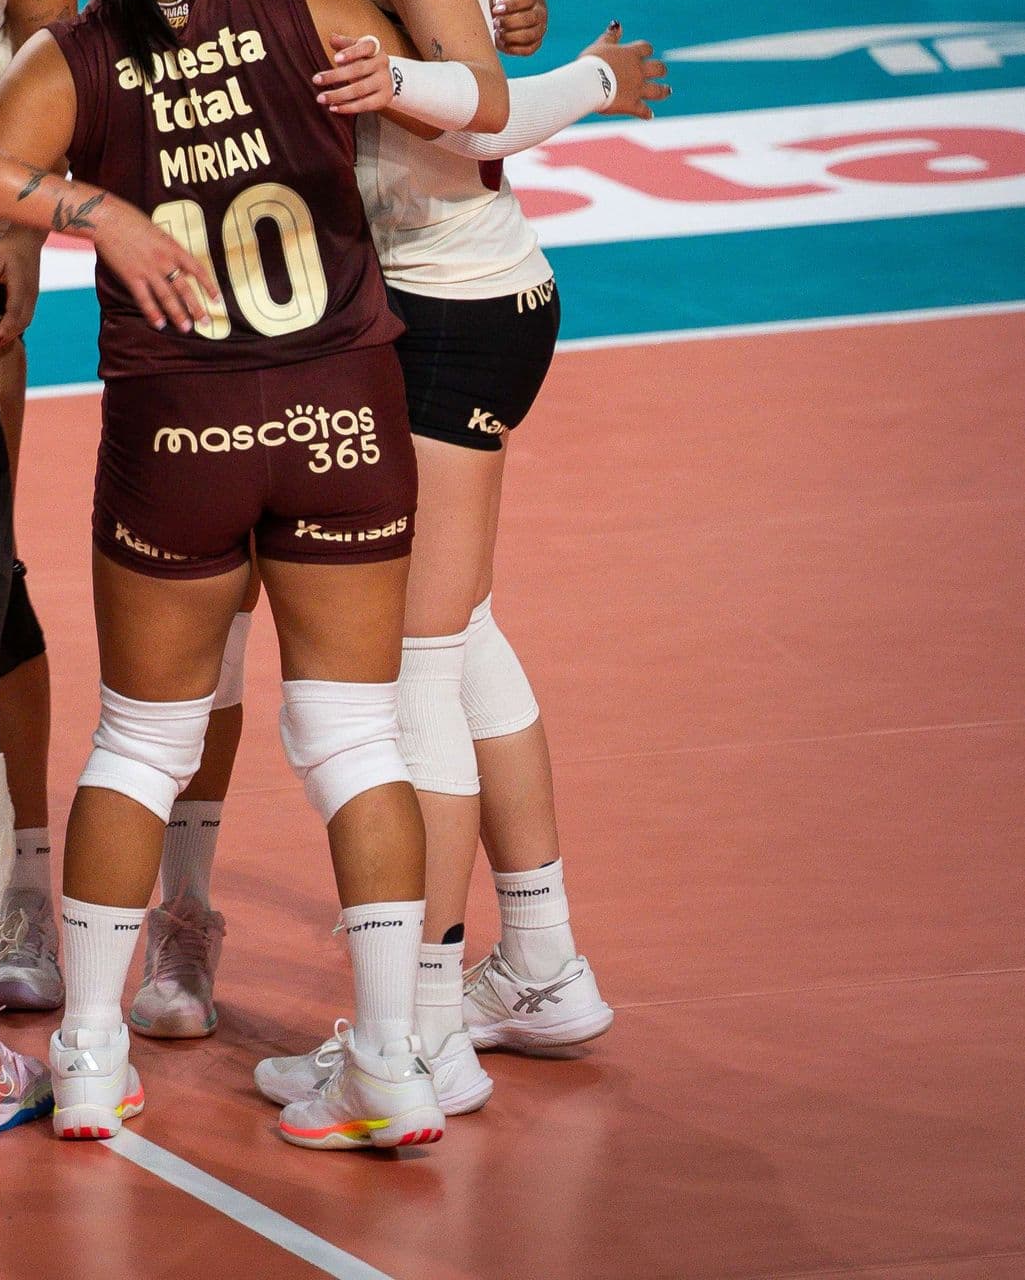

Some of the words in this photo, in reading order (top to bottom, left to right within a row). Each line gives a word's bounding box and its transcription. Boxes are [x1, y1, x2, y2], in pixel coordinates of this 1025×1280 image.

[152, 75, 253, 132] total
[159, 128, 271, 188] MIRIAN
[151, 182, 329, 341] 10
[154, 404, 375, 454] mascotas
[308, 433, 381, 474] 365
